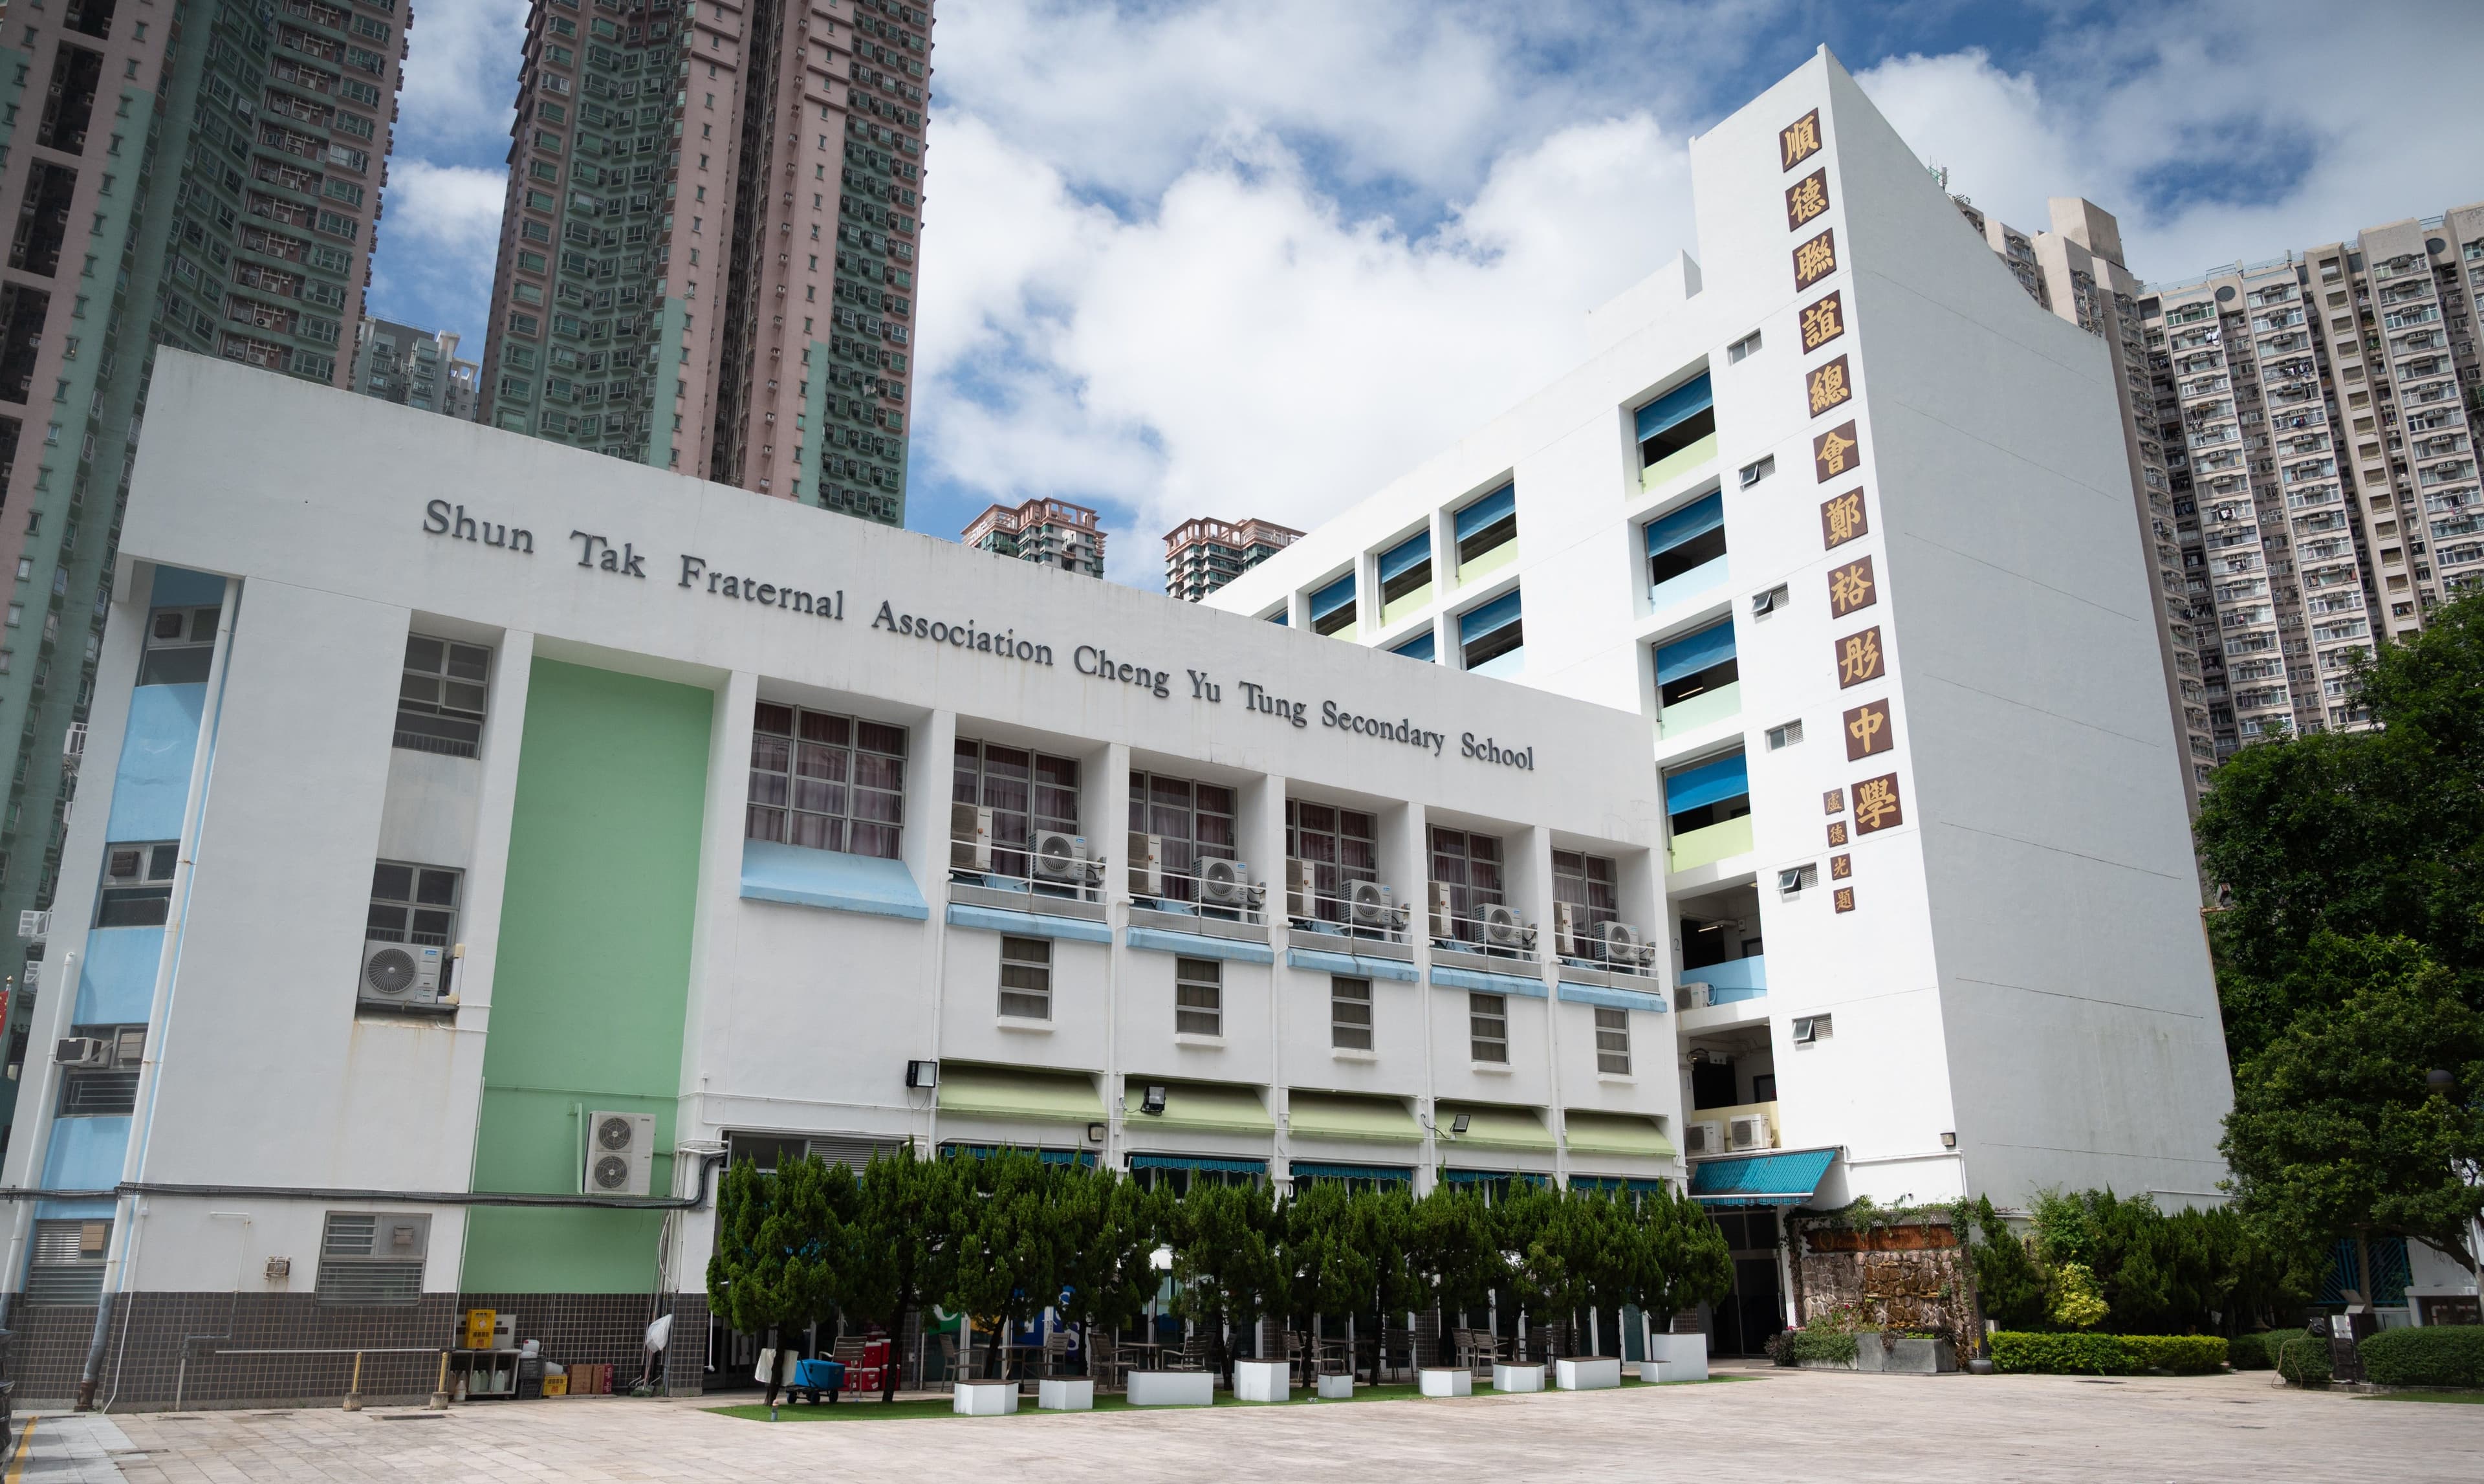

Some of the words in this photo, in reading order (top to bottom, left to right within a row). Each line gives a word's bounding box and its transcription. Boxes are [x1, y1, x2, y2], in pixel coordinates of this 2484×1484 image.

[1784, 115, 1899, 829] 順德聯誼總會鄭裕彤中學
[422, 499, 534, 555] Shun
[569, 529, 646, 580] Tak
[677, 554, 844, 622] Fraternal
[871, 600, 1054, 667] Association
[1073, 645, 1170, 700] Cheng
[1186, 669, 1222, 704] Yu
[1237, 680, 1308, 730] Tung
[1322, 700, 1446, 758] Secondary
[1461, 732, 1534, 772] School
[1673, 938, 1681, 951] 2
[1826, 792, 1854, 910] 盧德光題
